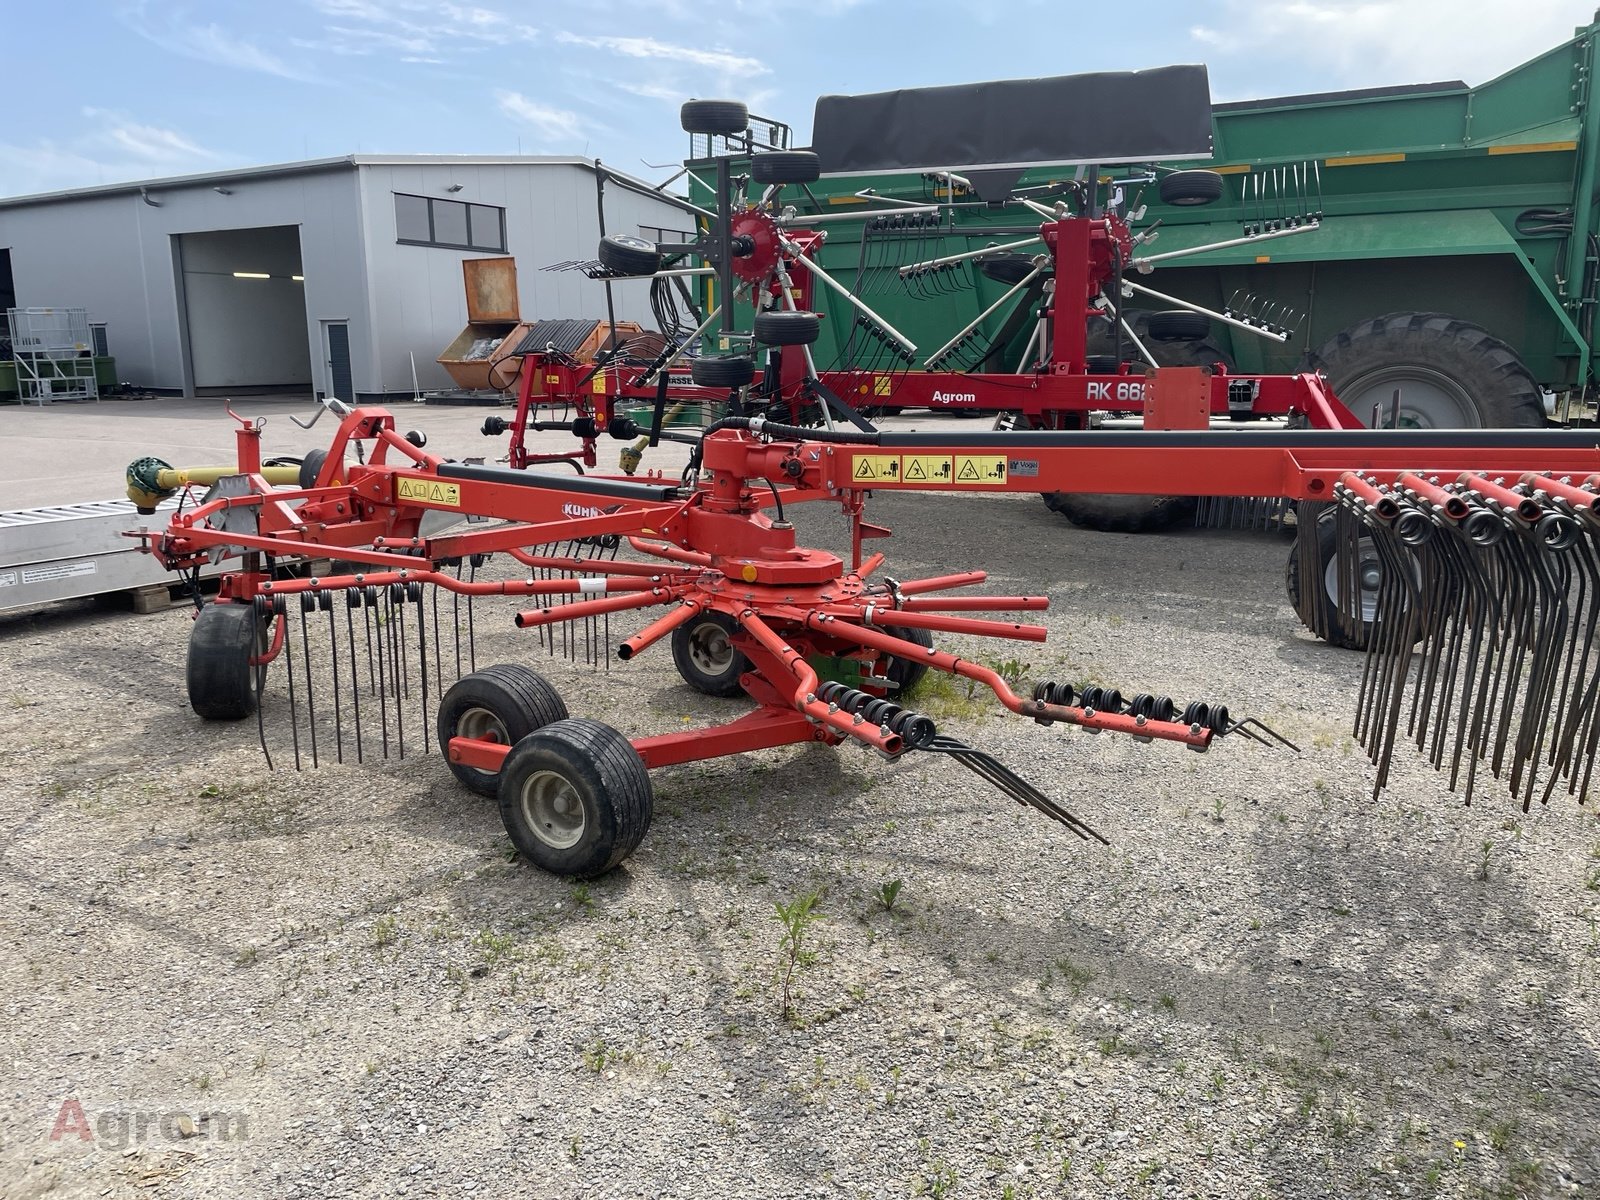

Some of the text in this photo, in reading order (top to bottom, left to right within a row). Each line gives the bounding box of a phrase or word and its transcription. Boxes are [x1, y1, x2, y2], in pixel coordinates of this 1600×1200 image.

[932, 390, 976, 404] Agrom
[1087, 382, 1112, 400] RK
[564, 503, 599, 518] KUHN
